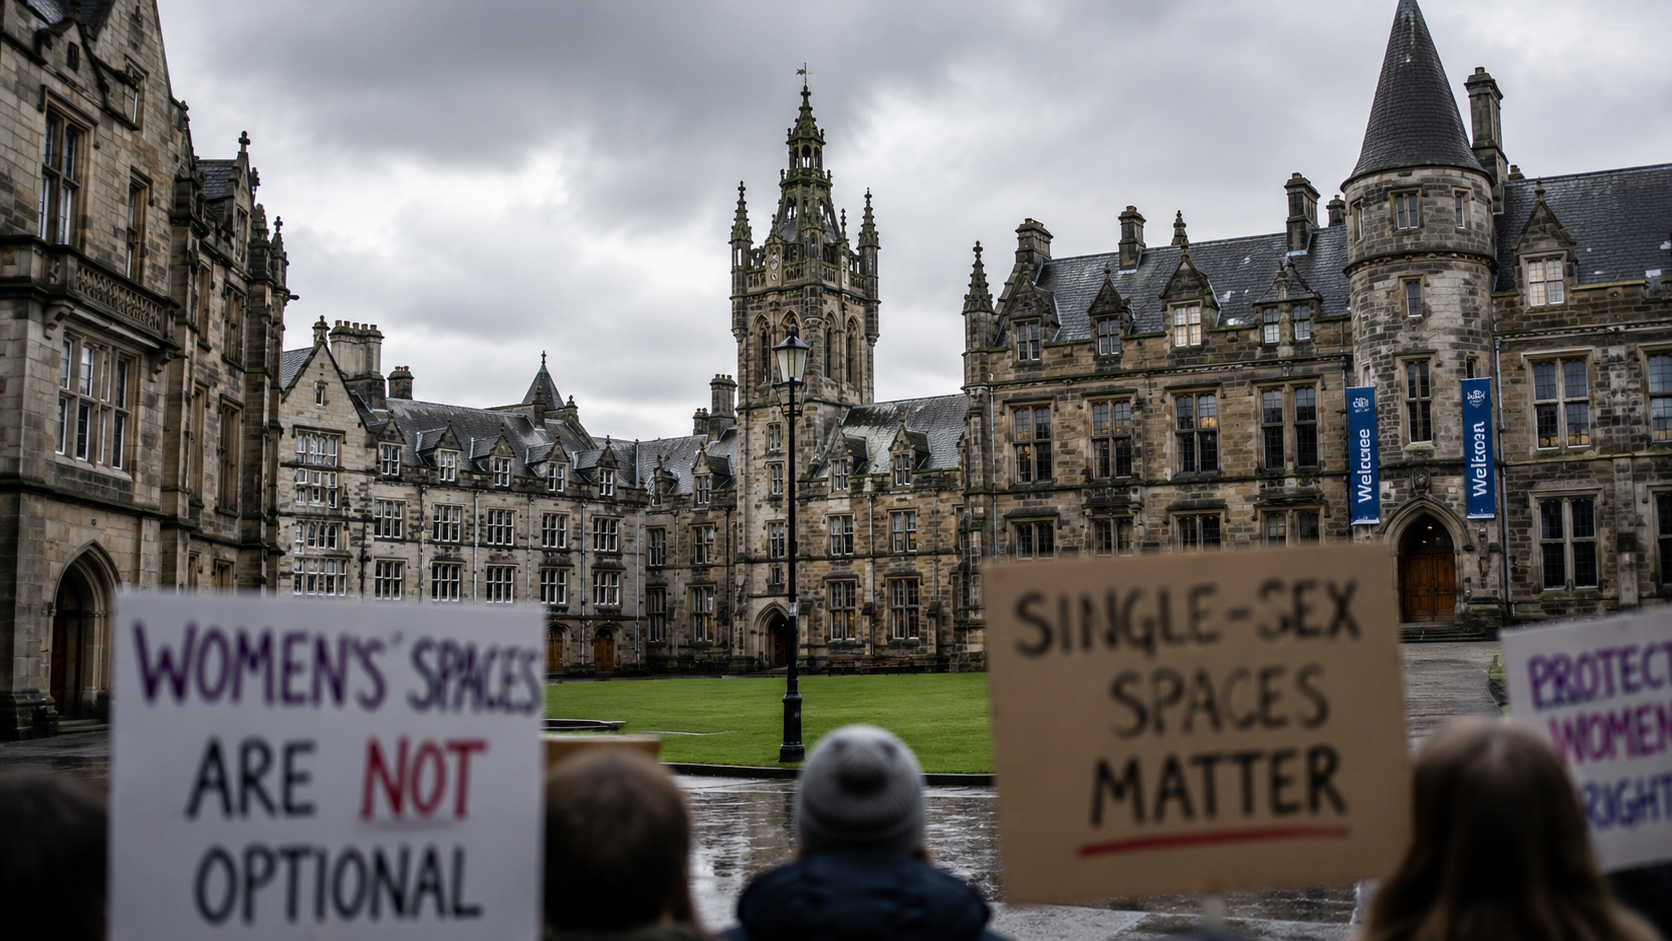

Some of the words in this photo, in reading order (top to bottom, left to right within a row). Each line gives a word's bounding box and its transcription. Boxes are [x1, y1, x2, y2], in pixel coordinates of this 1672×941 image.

[1013, 578, 1362, 659] SINGLE-SEX
[407, 636, 543, 715] SPACES
[1108, 664, 1331, 740] SPACES
[183, 736, 318, 821] ARE
[359, 734, 490, 823] NOT
[1090, 744, 1348, 828] MATTER
[195, 843, 484, 926] OPTIONAL
